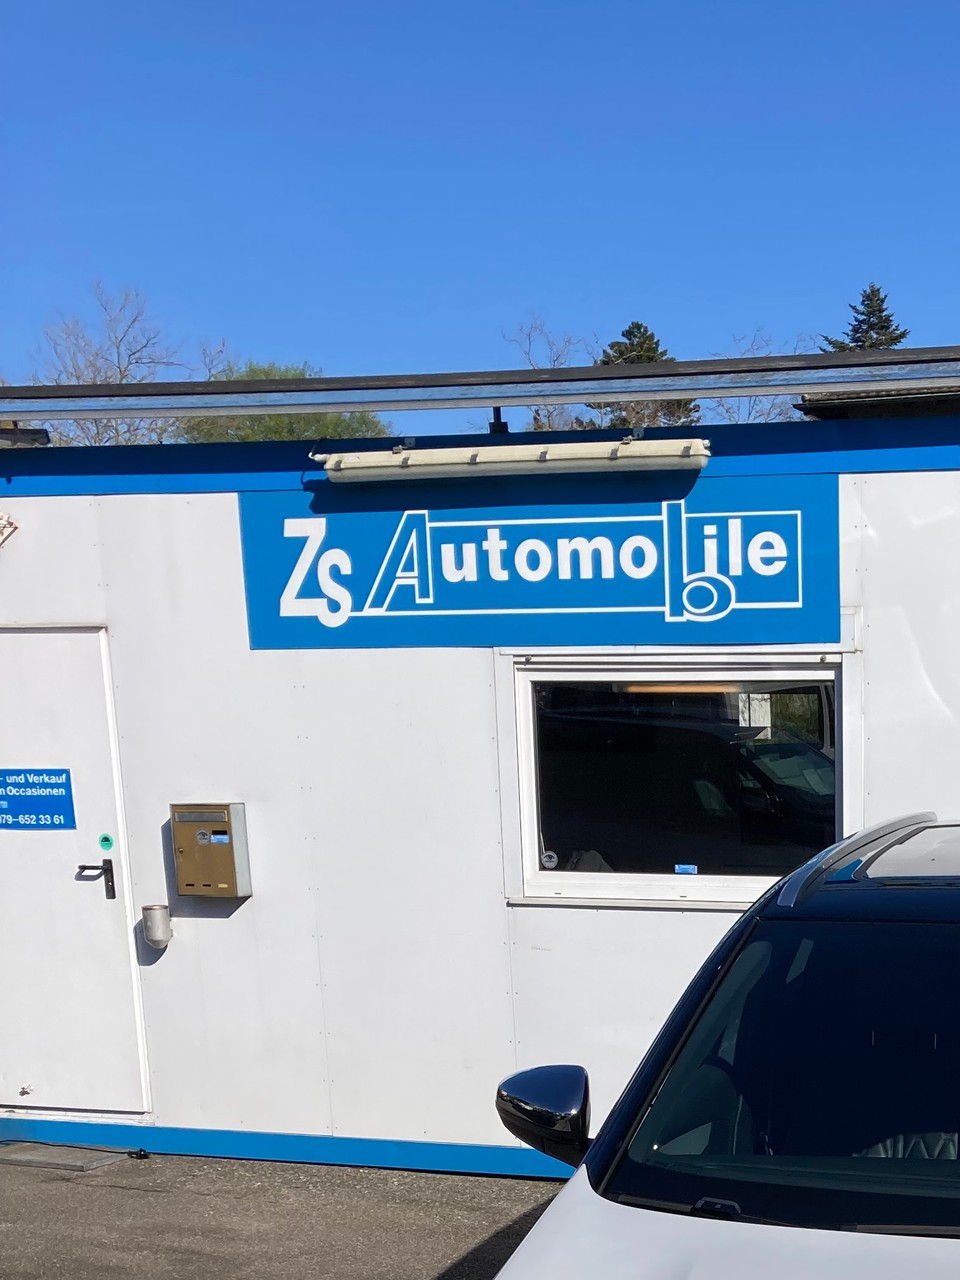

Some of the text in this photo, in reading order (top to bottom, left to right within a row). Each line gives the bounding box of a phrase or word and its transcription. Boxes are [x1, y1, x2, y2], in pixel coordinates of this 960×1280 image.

[363, 500, 788, 622] Automobile
[6, 774, 25, 783] und
[26, 774, 66, 783] Verkauf
[6, 786, 66, 796] Occasionen
[0, 814, 65, 825] 79-652 33 61
